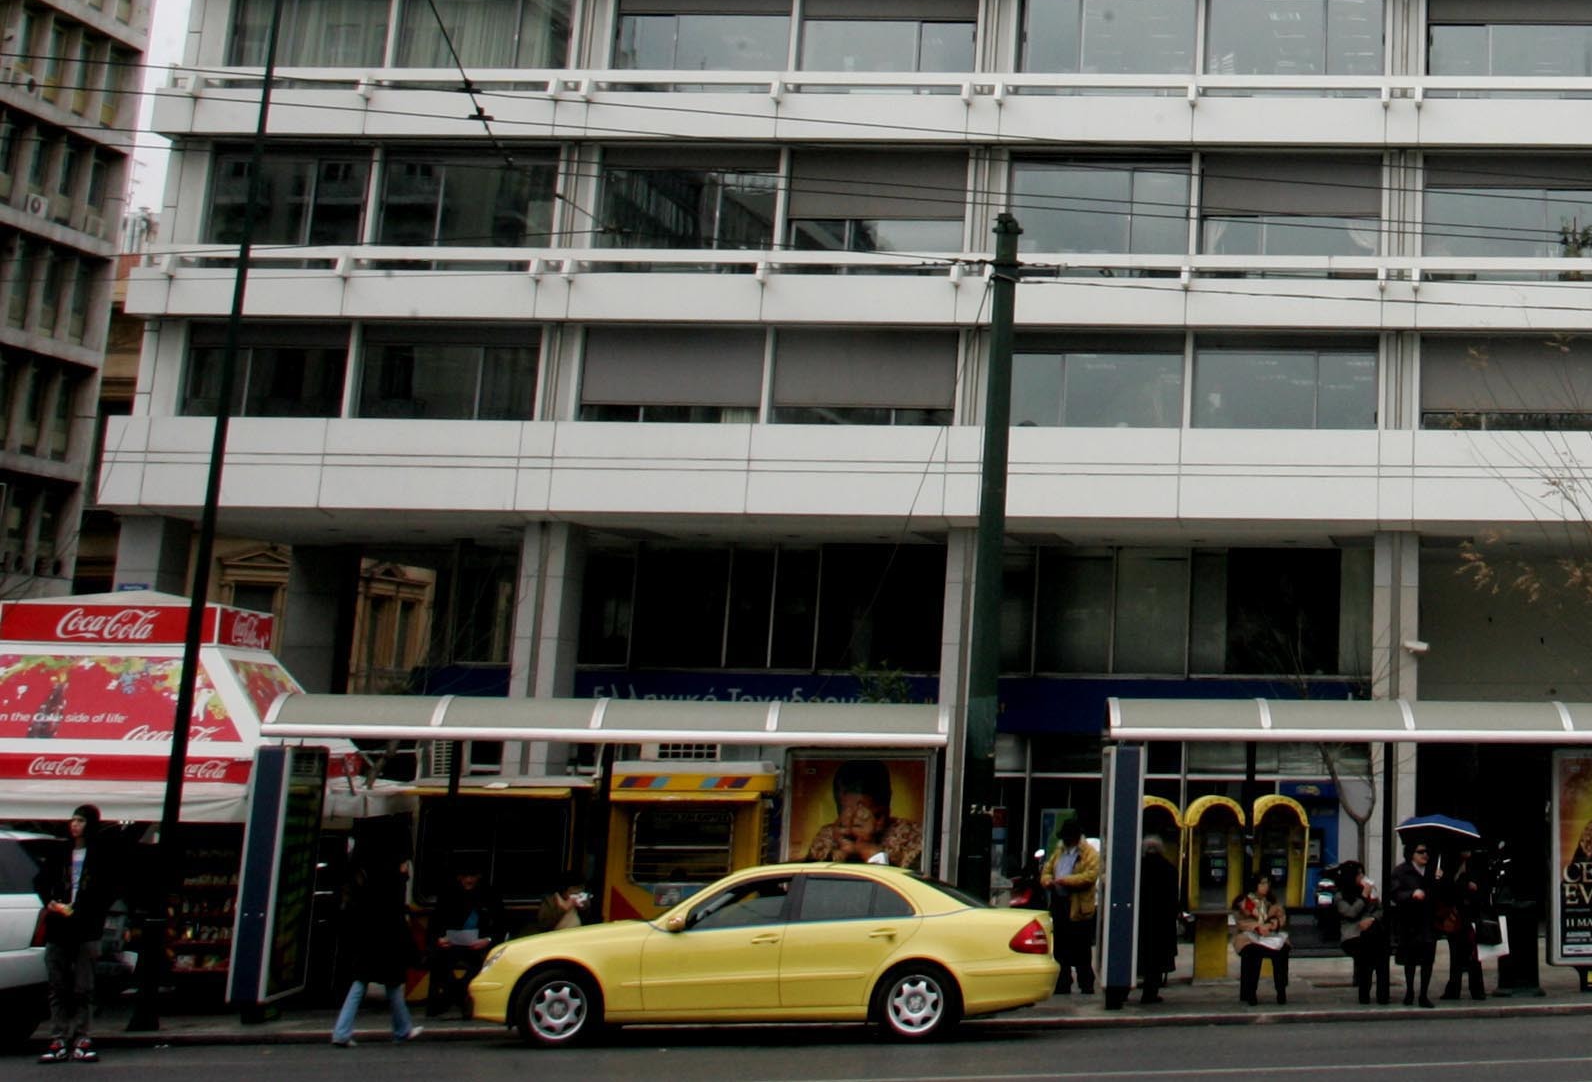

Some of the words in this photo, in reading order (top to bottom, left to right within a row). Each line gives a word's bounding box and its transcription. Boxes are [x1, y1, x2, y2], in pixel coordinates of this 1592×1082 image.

[56, 607, 160, 639] Coca-Cola
[10, 711, 31, 722] the
[64, 712, 90, 723] side
[91, 712, 105, 723] of
